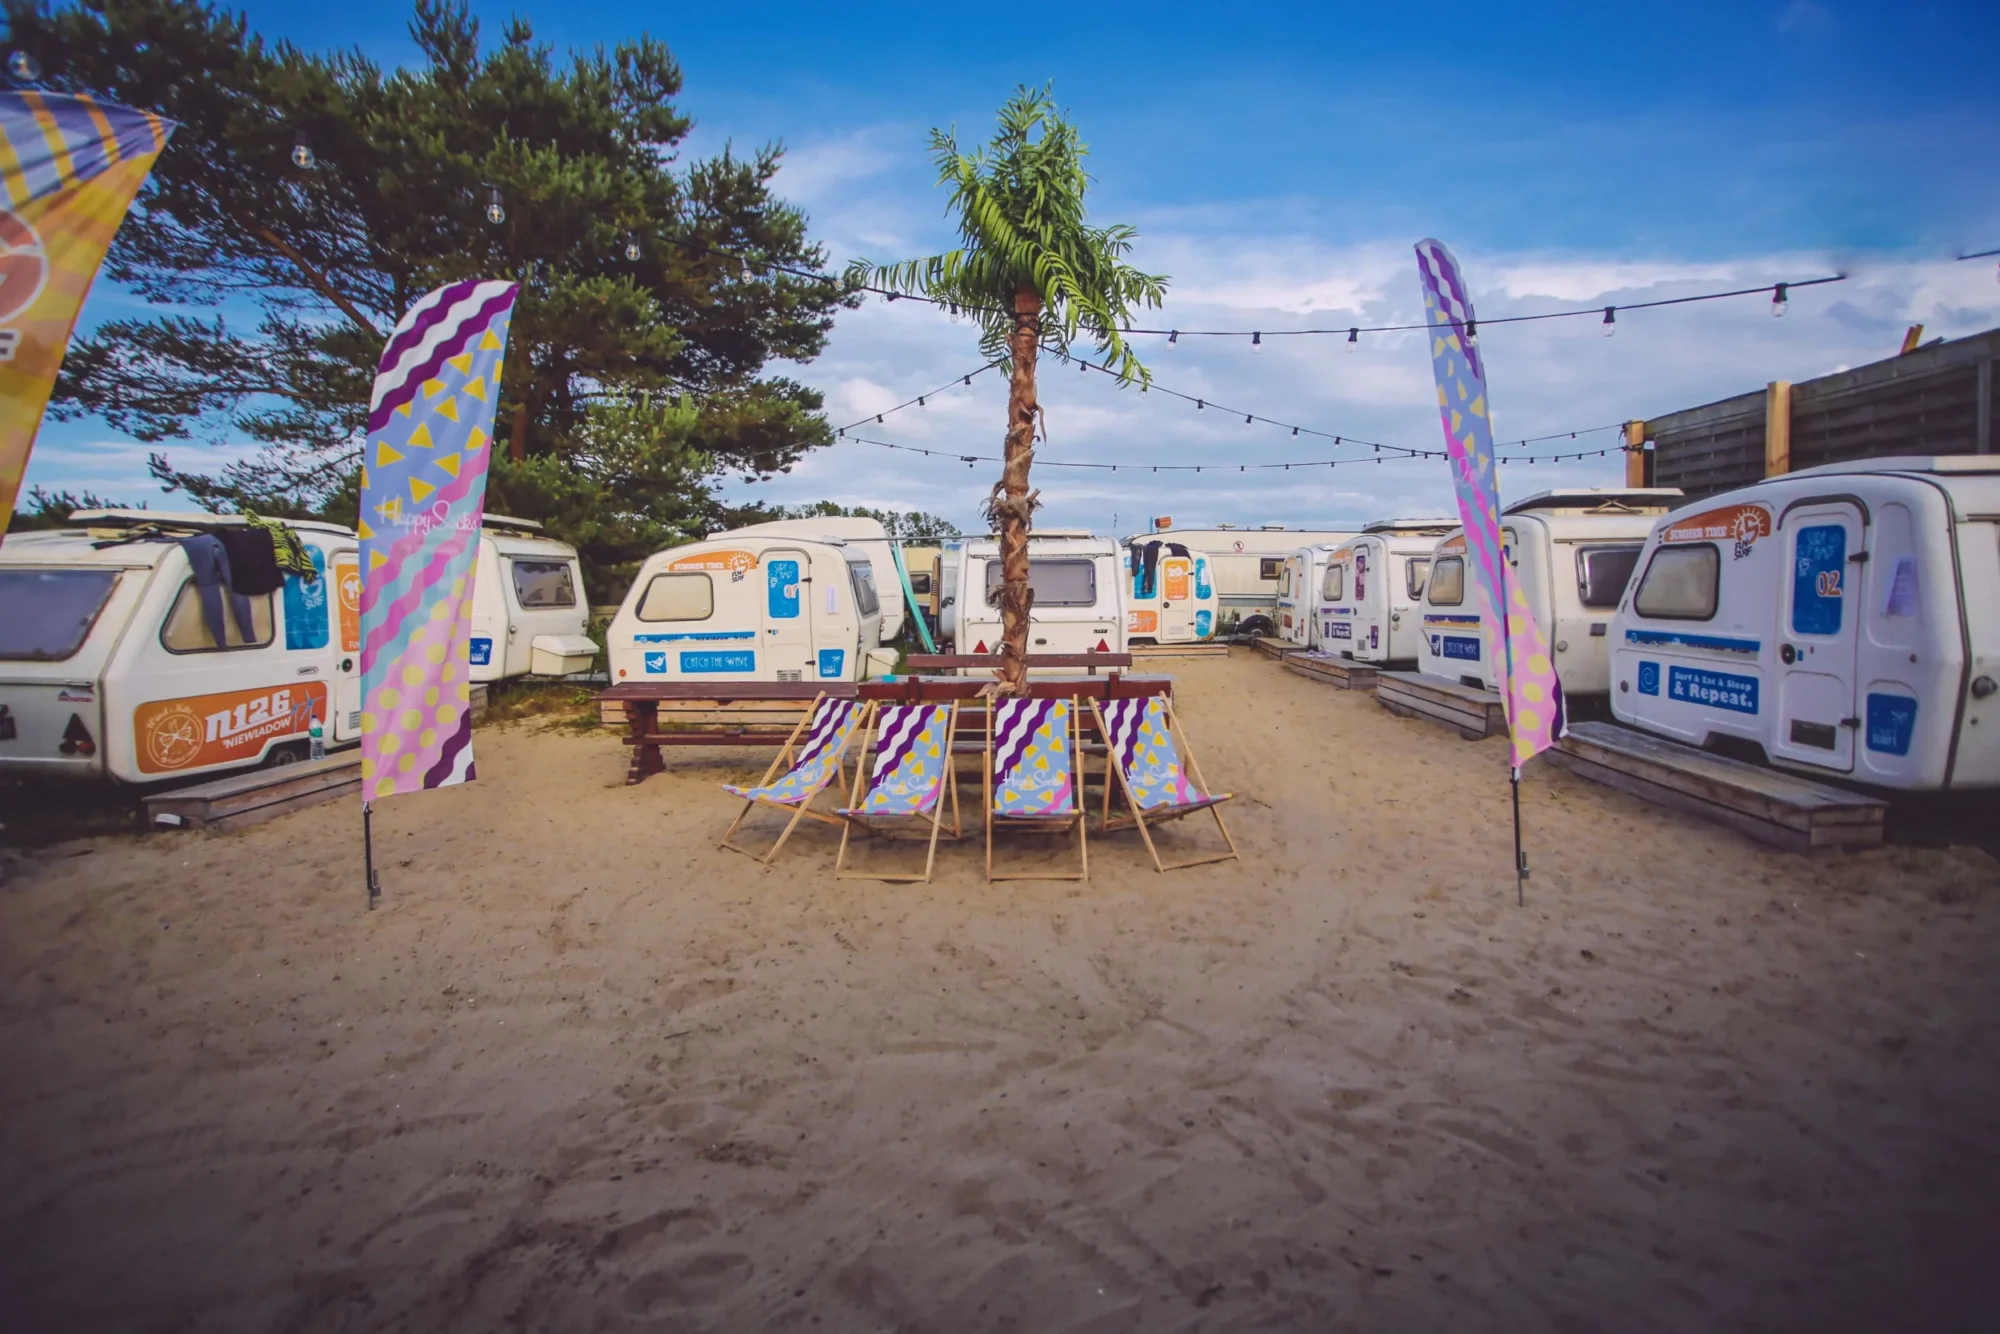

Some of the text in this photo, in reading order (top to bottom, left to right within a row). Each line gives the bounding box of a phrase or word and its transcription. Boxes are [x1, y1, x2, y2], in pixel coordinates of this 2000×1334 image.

[1734, 546, 1752, 560] SURF
[1735, 539, 1749, 551] FUN
[1816, 570, 1843, 598] 02
[685, 656, 748, 668] CATCH THE WAVE
[1674, 672, 1692, 681] Surf
[1702, 676, 1716, 685] Eat
[1727, 680, 1752, 692] Sleep
[1674, 681, 1753, 708] & Repeat.
[222, 716, 293, 748] NIEWIADOW
